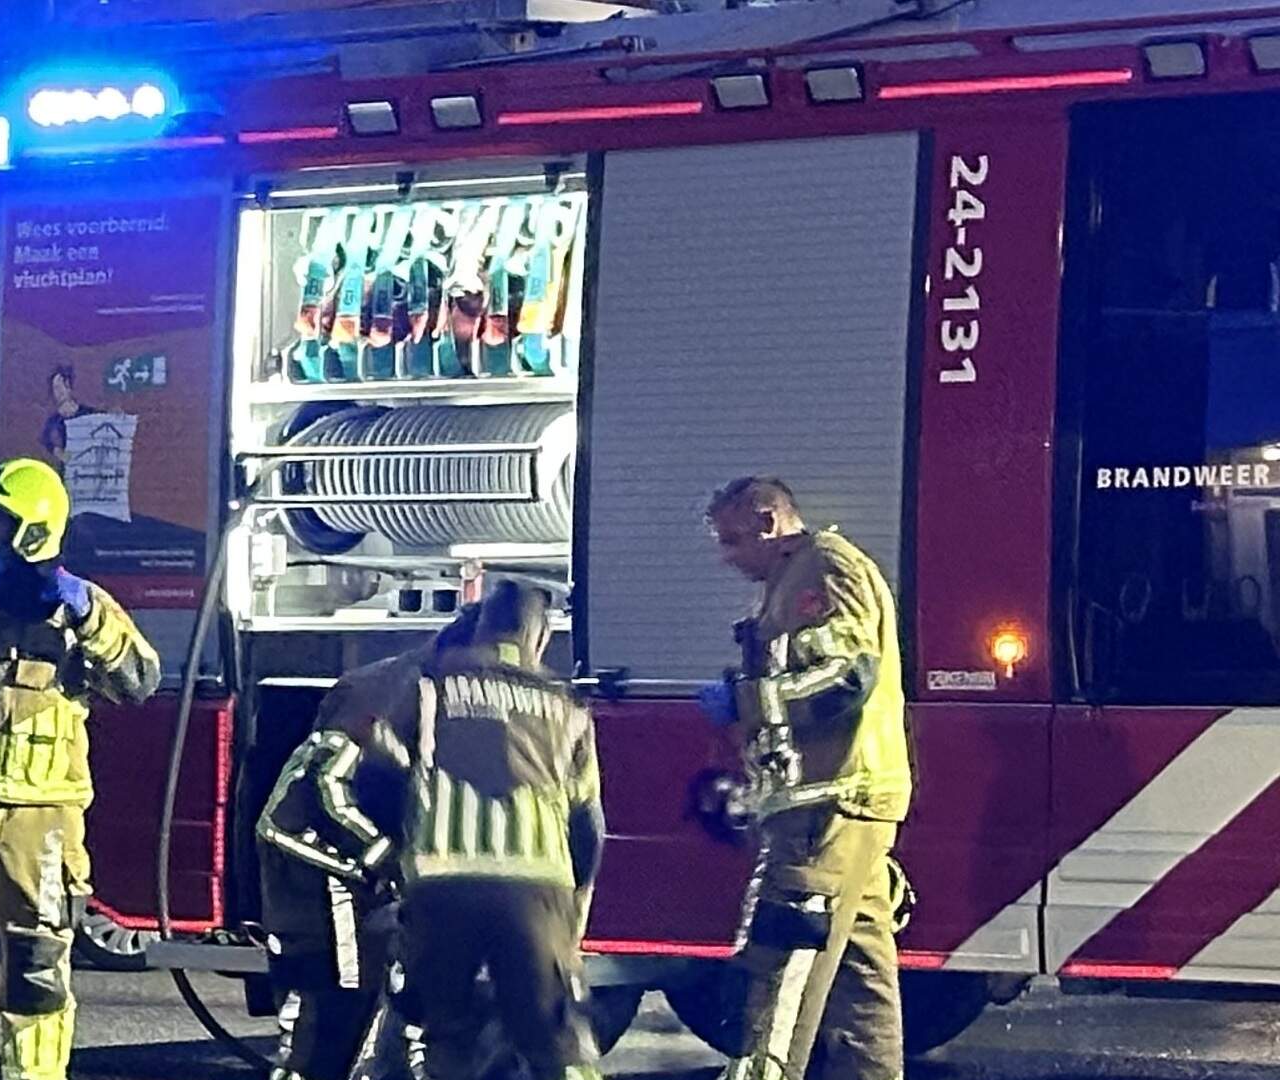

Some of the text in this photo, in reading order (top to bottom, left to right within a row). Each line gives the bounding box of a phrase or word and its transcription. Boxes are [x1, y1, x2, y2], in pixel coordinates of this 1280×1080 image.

[16, 220, 62, 238] Wees
[13, 243, 99, 264] Maak een
[939, 155, 989, 383] 24-2131
[1096, 463, 1271, 489] BRANDWEER
